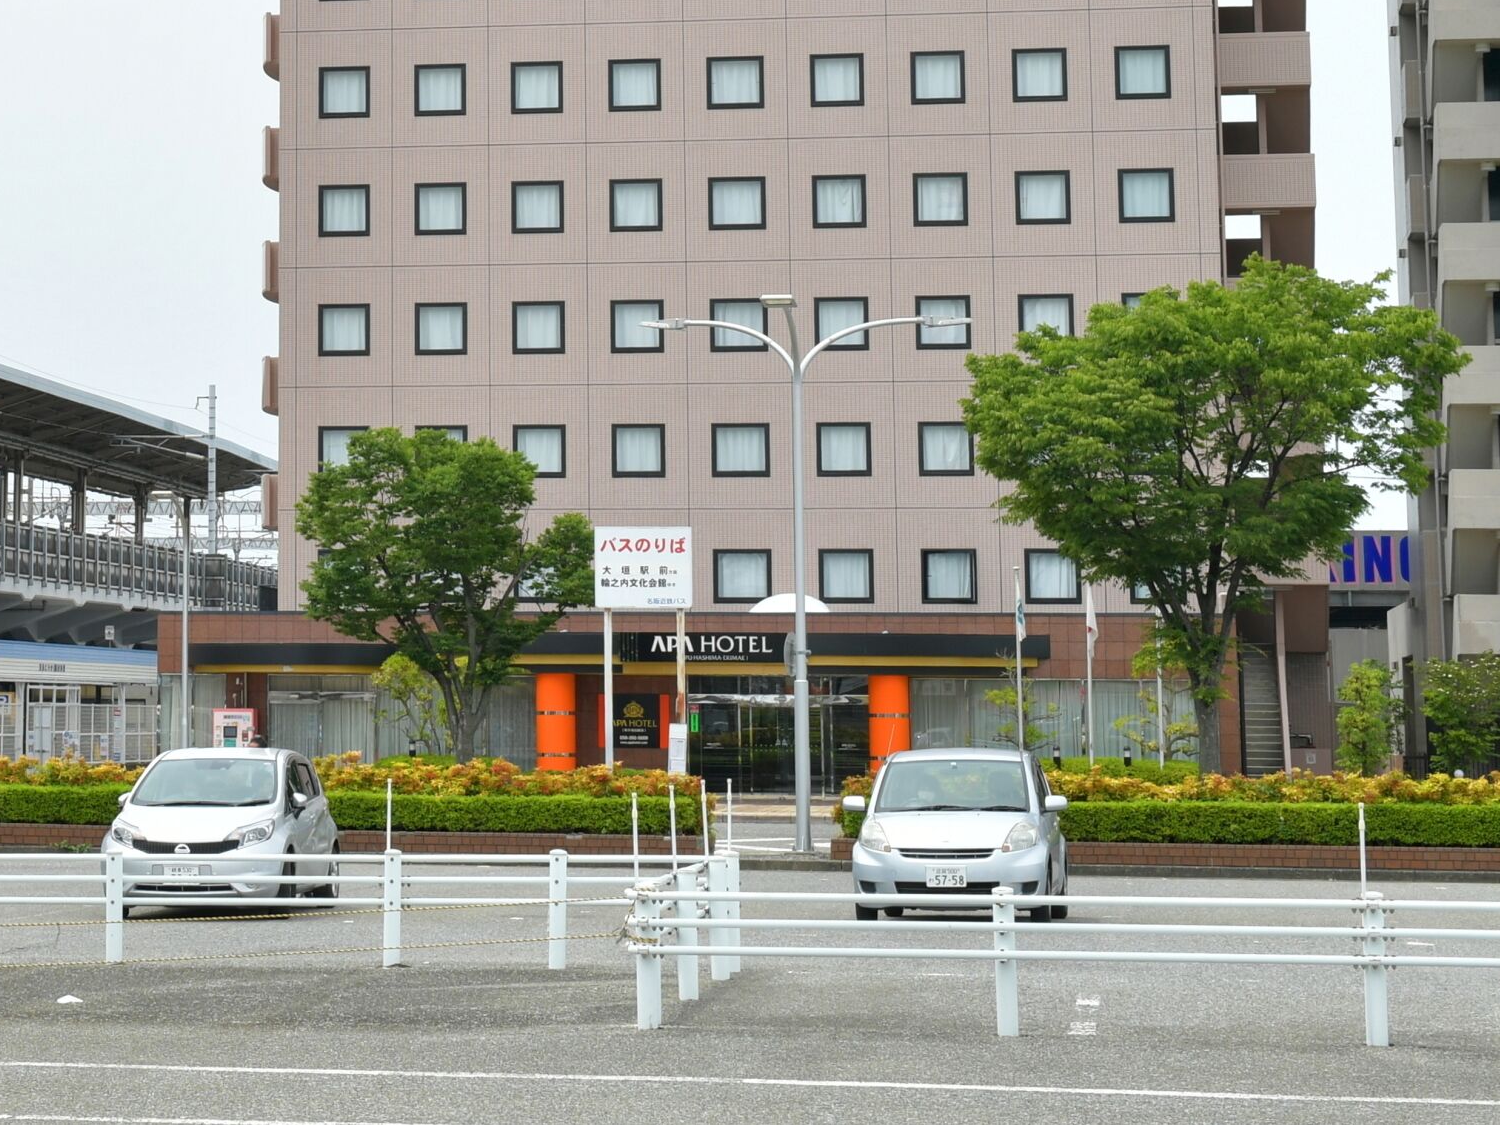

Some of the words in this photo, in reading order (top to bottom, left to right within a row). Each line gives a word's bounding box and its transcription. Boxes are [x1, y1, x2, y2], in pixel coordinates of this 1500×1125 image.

[600, 537, 686, 554] バスのりば
[700, 635, 773, 653] HOTEL
[628, 719, 657, 728] HOTEL
[934, 874, 965, 886] 57-58
